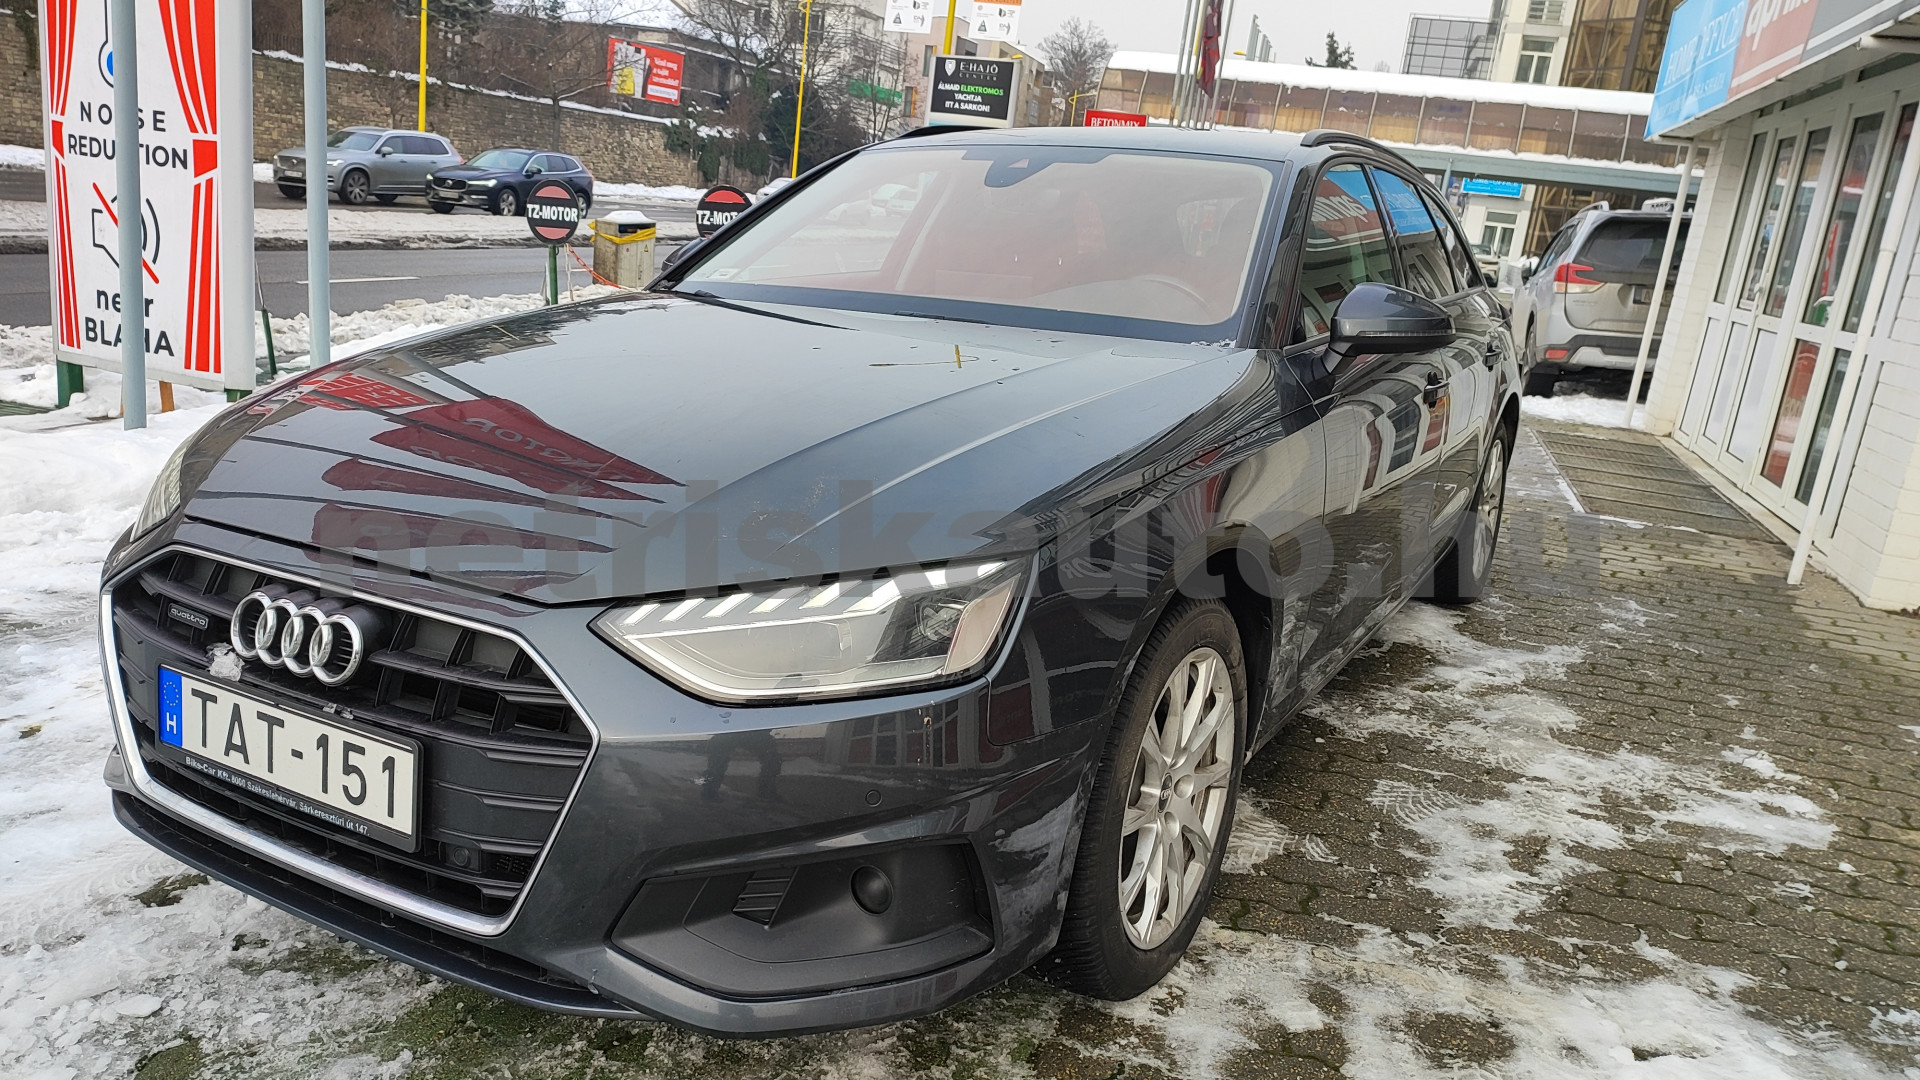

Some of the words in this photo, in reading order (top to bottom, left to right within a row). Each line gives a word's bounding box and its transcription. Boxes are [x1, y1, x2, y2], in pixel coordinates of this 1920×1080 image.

[960, 61, 999, 74] E-HAJÓ
[938, 81, 960, 91] ÁLMAID
[961, 84, 1004, 96] ELEKTROMOS
[954, 93, 982, 103] YACHTJA
[954, 101, 960, 109] A
[960, 102, 990, 113] SARKON!
[80, 101, 166, 132] NOSE
[1091, 117, 1140, 127] BETONMIX
[68, 133, 188, 170] REDUION
[526, 203, 578, 222] TZ-MOTOR
[696, 210, 743, 226] TZ-MOT
[97, 289, 154, 318] ner
[170, 608, 206, 626] quattro
[166, 712, 177, 735] H
[191, 688, 396, 819] TAT-151
[217, 769, 231, 782] Kft.
[231, 774, 246, 788] 8000
[299, 801, 345, 826] Sárkeresztúri
[346, 819, 354, 830] út
[355, 822, 370, 836] 147.
